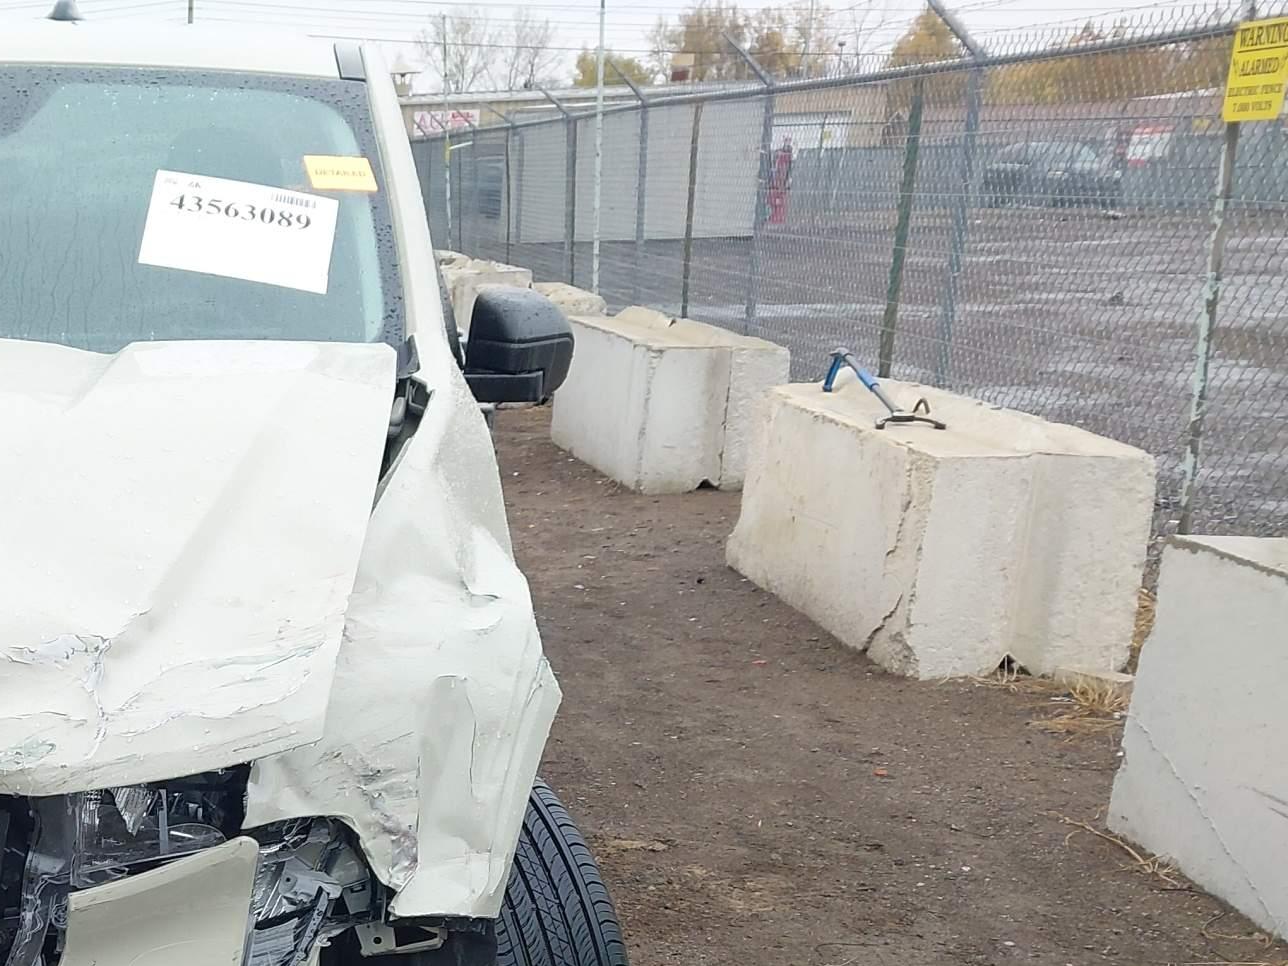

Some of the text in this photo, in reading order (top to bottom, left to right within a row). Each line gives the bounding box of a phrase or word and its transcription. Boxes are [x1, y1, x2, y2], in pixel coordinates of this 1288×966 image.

[1240, 57, 1279, 76] ALARMED
[1227, 84, 1283, 97] ELECTRIC FENCE
[1252, 101, 1272, 111] VOLTS
[168, 193, 312, 230] 43563089
